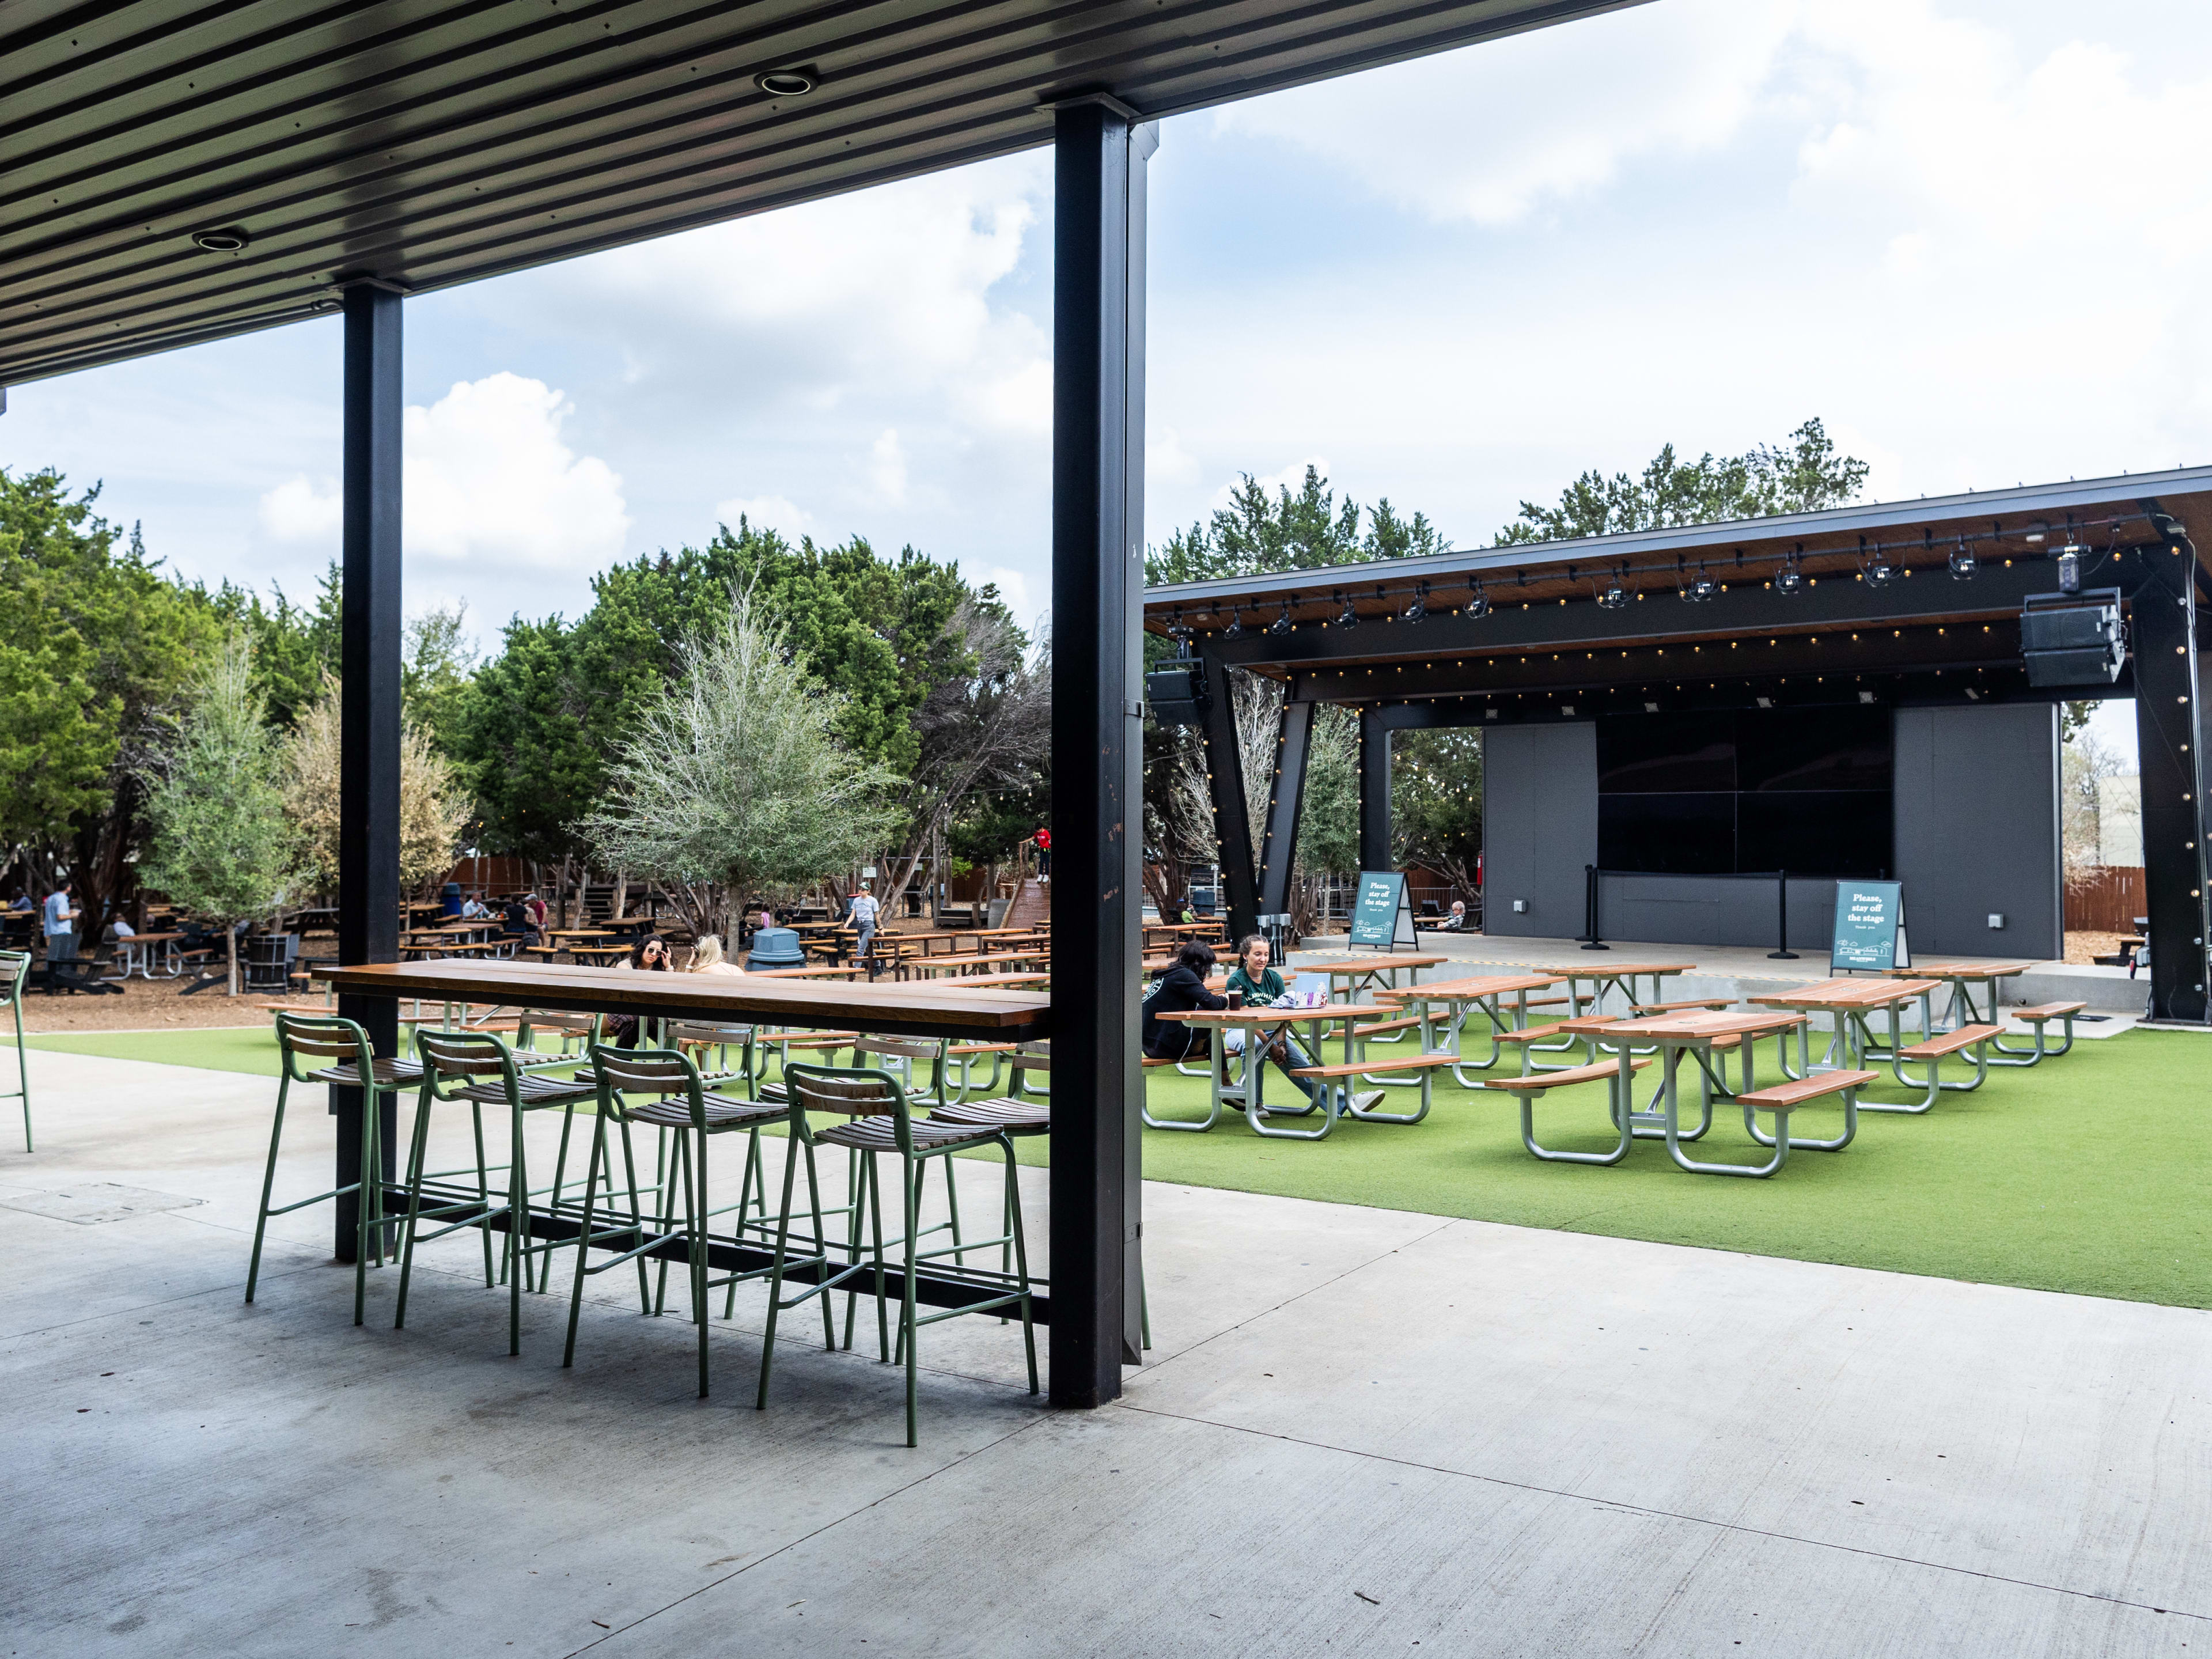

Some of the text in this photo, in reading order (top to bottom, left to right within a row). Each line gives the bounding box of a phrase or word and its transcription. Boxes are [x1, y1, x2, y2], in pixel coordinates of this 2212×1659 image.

[1853, 894, 1882, 903] Please,
[1863, 915, 1884, 923] stage
[1245, 993, 1274, 1001] EANWHIL
